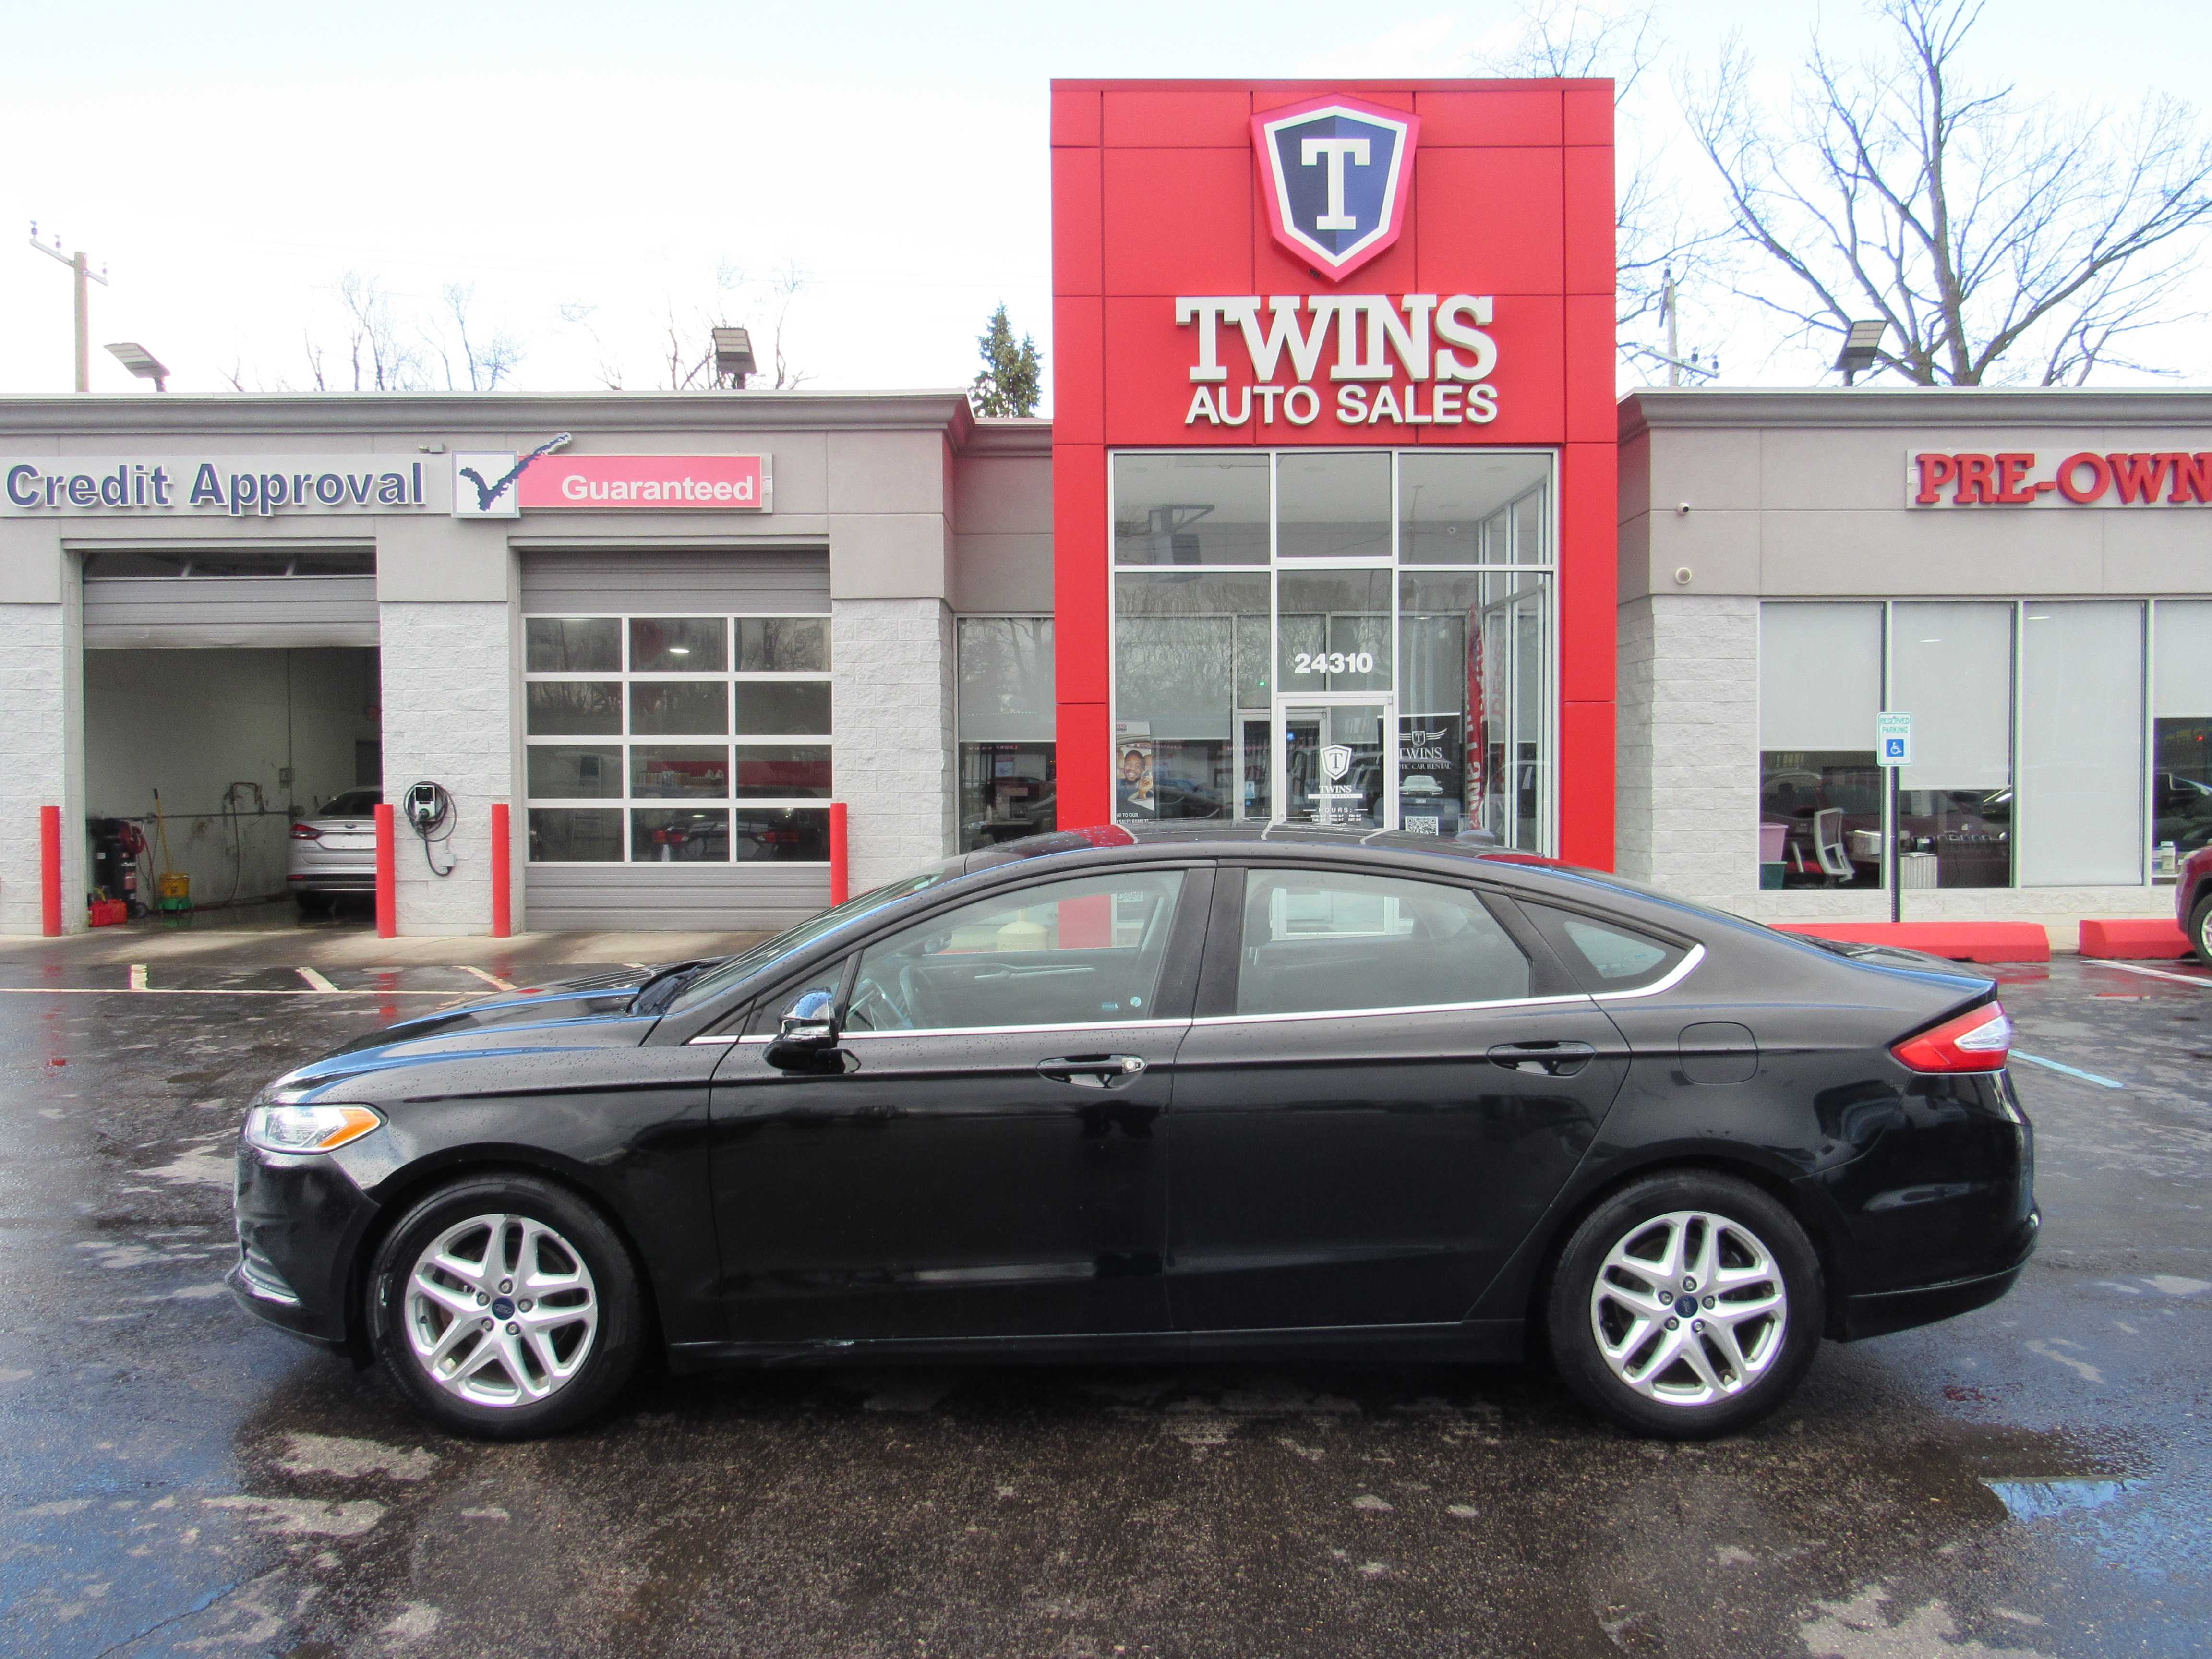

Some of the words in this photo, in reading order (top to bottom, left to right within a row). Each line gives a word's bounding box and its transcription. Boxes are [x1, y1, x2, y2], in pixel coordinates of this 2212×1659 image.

[1301, 138, 1370, 230] T
[1175, 294, 1497, 383] TWINS
[1185, 385, 1320, 425] AUTO
[1336, 384, 1498, 424] SALES
[6, 463, 172, 507] Credit
[189, 462, 425, 517] Approval
[562, 475, 753, 501] Guaranteed
[1294, 652, 1373, 674] 24310
[1319, 785, 1352, 793] TWINS
